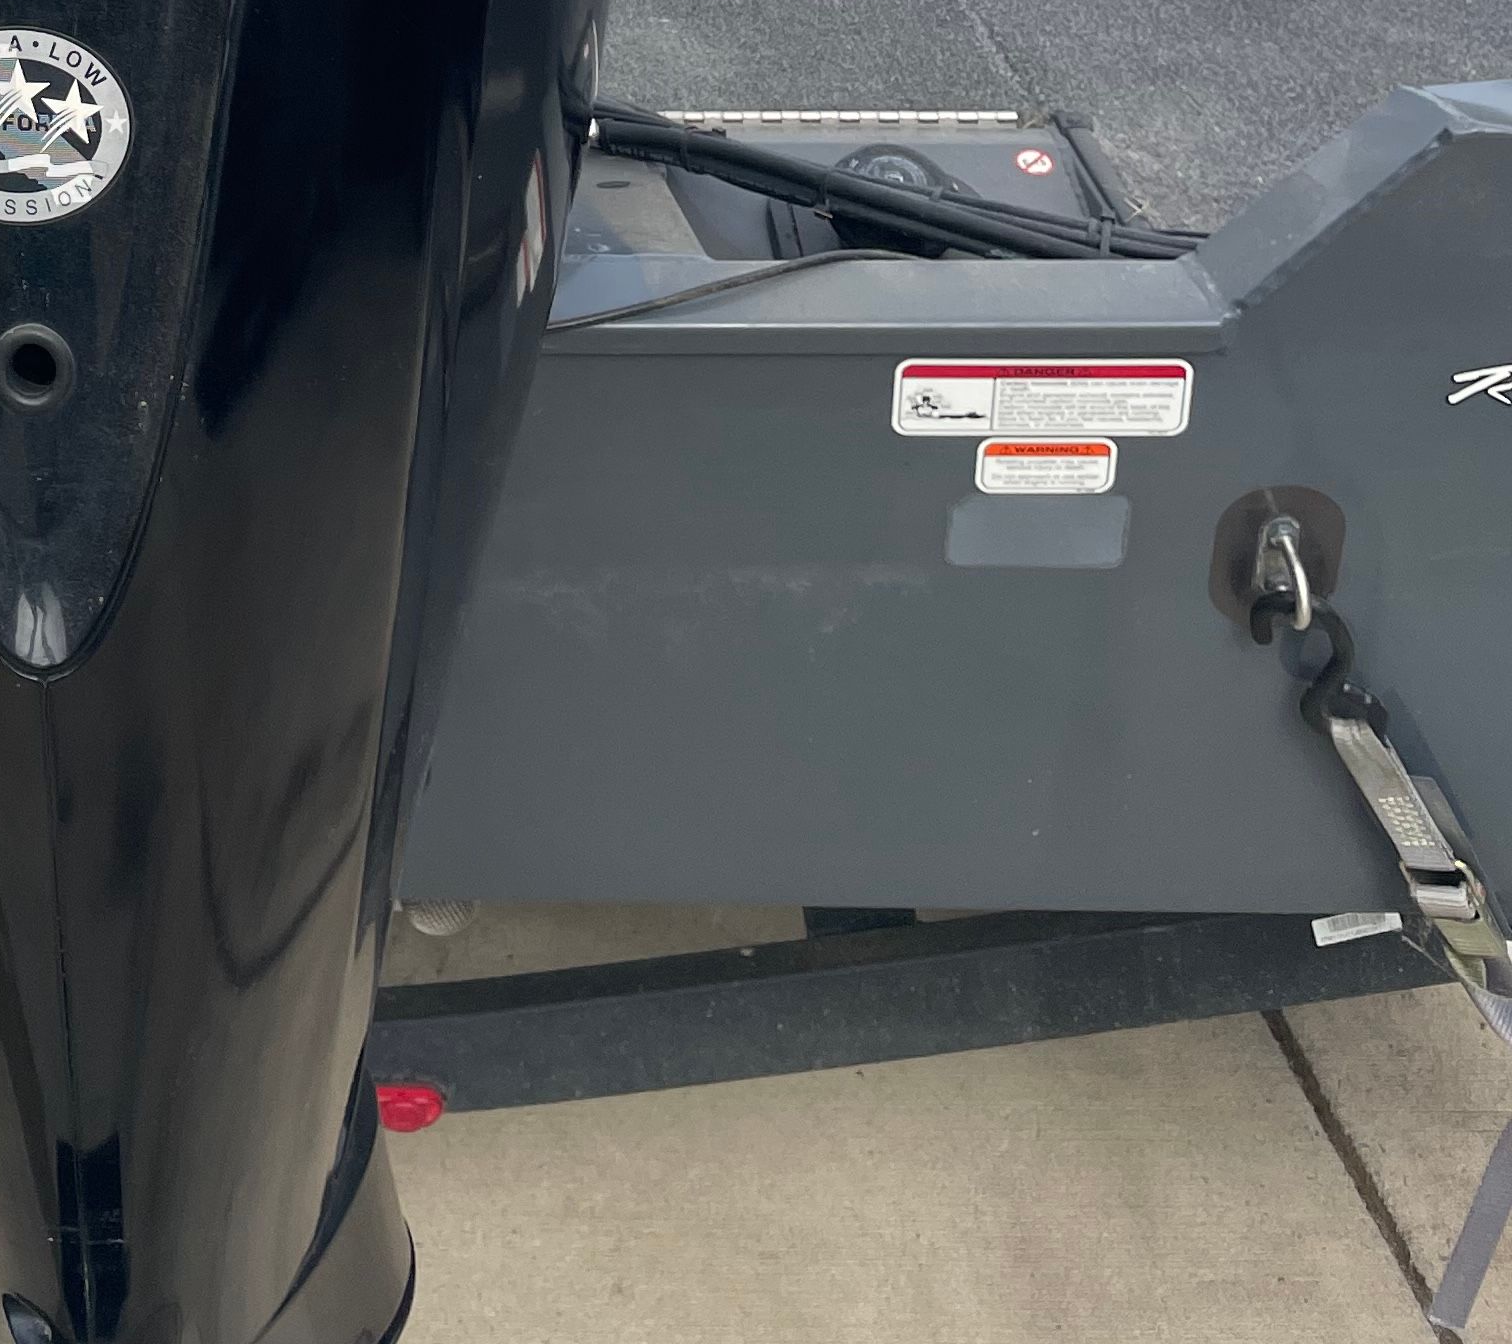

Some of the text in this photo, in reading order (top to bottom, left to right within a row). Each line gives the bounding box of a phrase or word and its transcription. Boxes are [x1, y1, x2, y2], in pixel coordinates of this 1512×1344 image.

[48, 41, 108, 88] LOW
[1013, 367, 1076, 377] DANGER
[1014, 445, 1080, 454] WARNING
